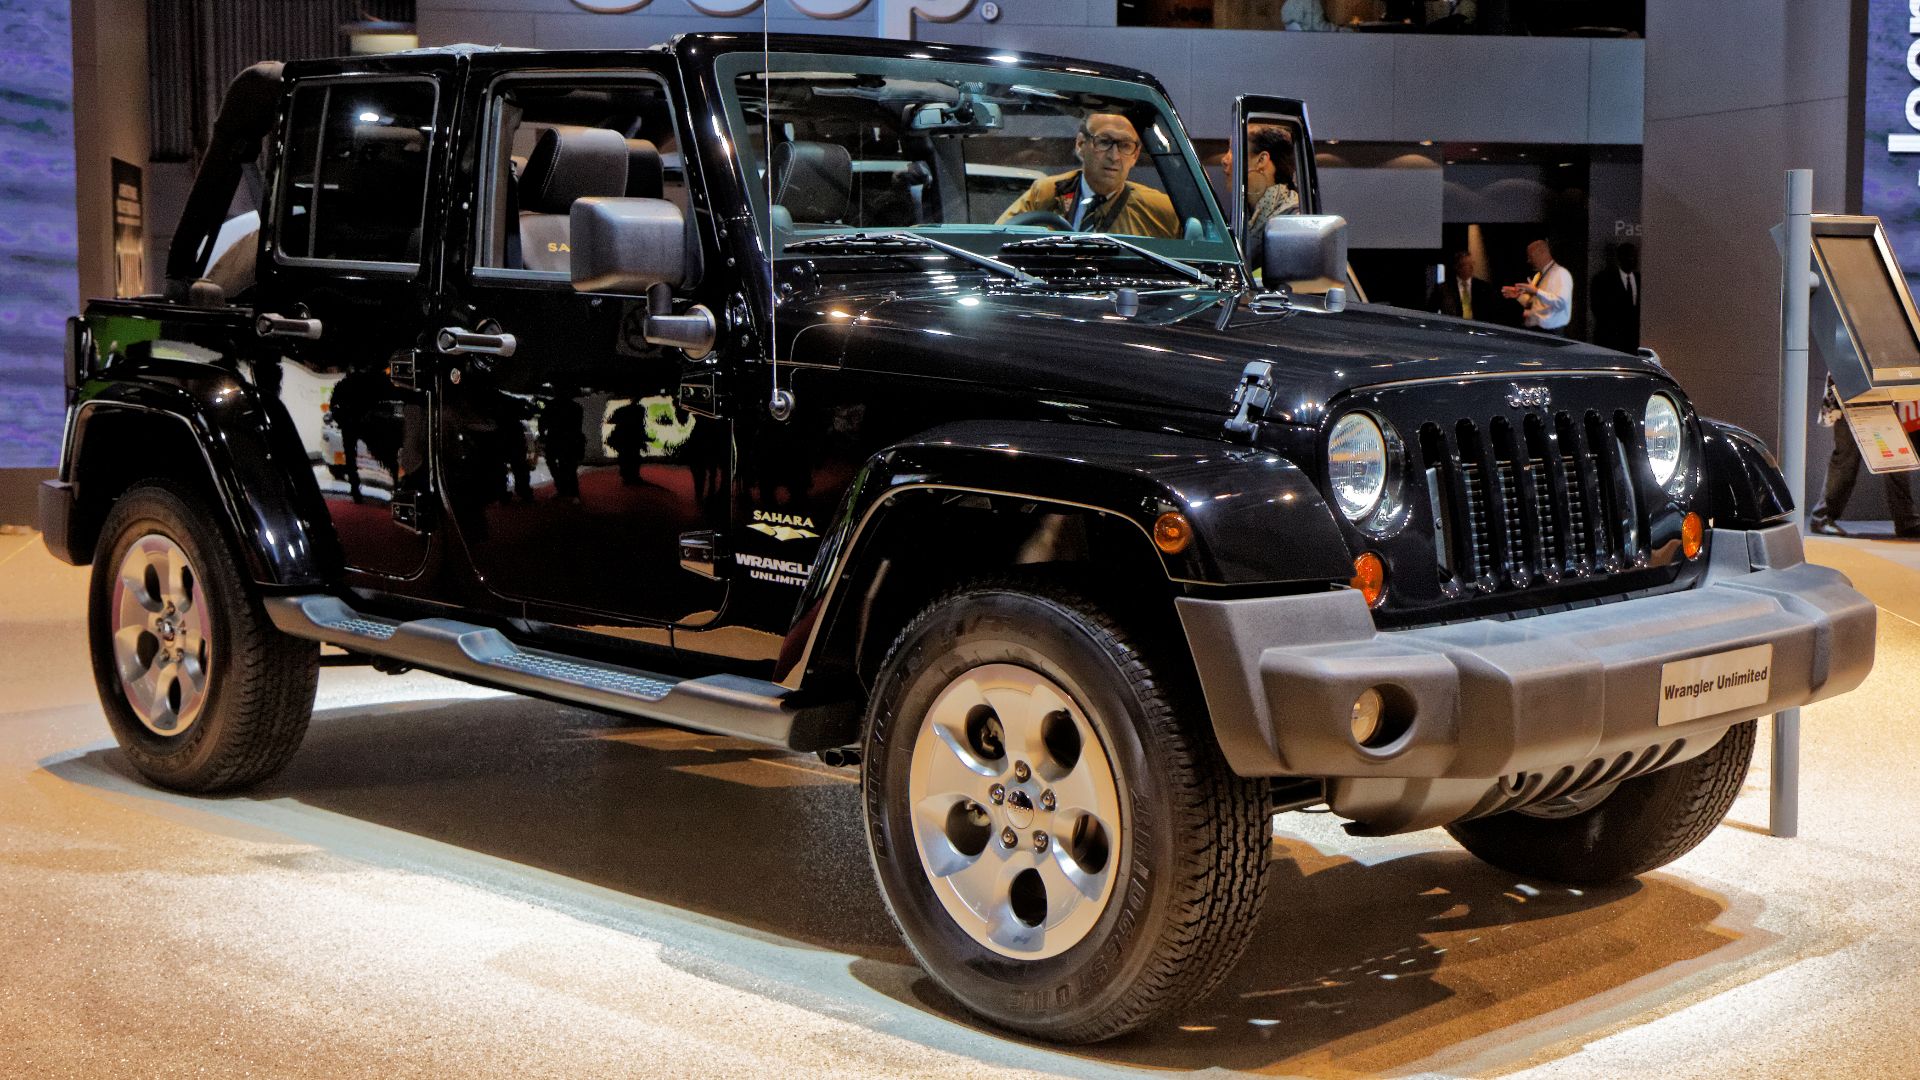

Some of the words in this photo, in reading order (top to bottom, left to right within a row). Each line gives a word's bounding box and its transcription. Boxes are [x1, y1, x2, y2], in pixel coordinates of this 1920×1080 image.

[547, 242, 570, 252] SA
[1504, 382, 1551, 413] Jeep
[753, 509, 815, 528] SAHARA
[1664, 679, 1715, 700] Wrangler
[1717, 666, 1768, 690] Unlimited
